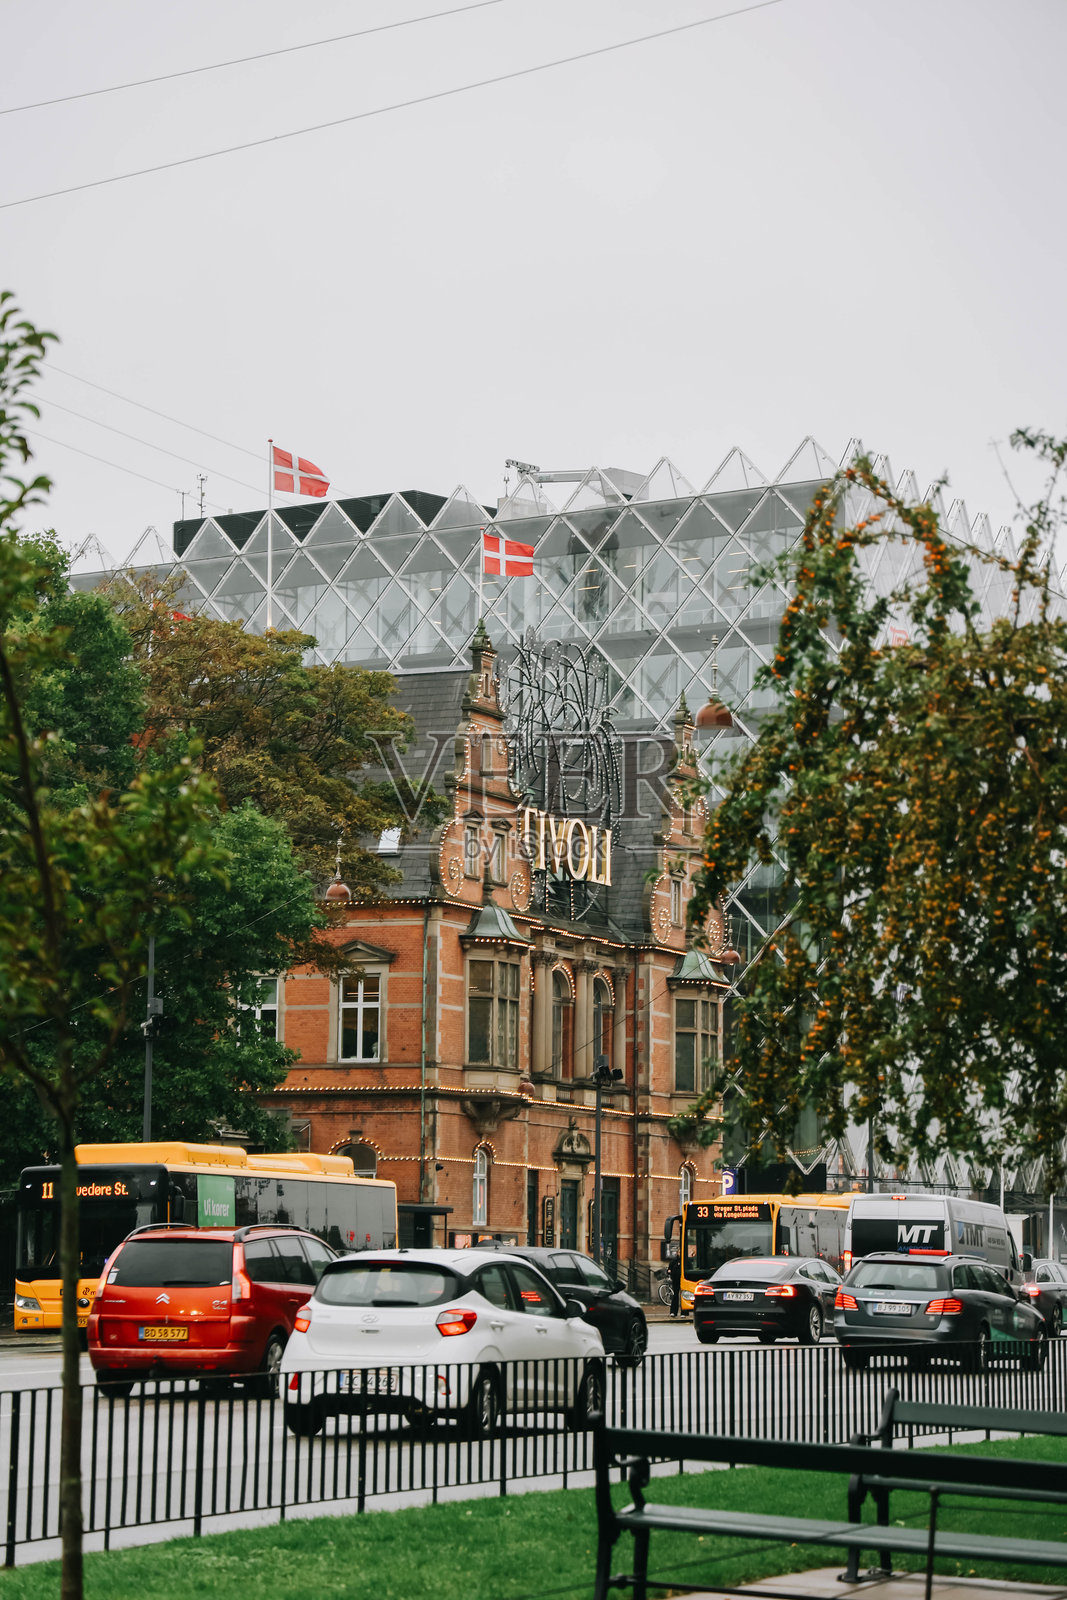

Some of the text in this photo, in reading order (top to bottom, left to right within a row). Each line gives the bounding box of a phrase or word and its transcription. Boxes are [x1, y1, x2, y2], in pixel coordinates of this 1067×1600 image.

[521, 806, 613, 887] TIVOLI
[42, 1181, 128, 1199] 11 vedøre St.
[722, 1174, 734, 1195] P
[203, 1199, 211, 1217] Vi
[697, 1206, 709, 1218] 33
[158, 1328, 168, 1338] 58
[170, 1328, 187, 1338] 577
